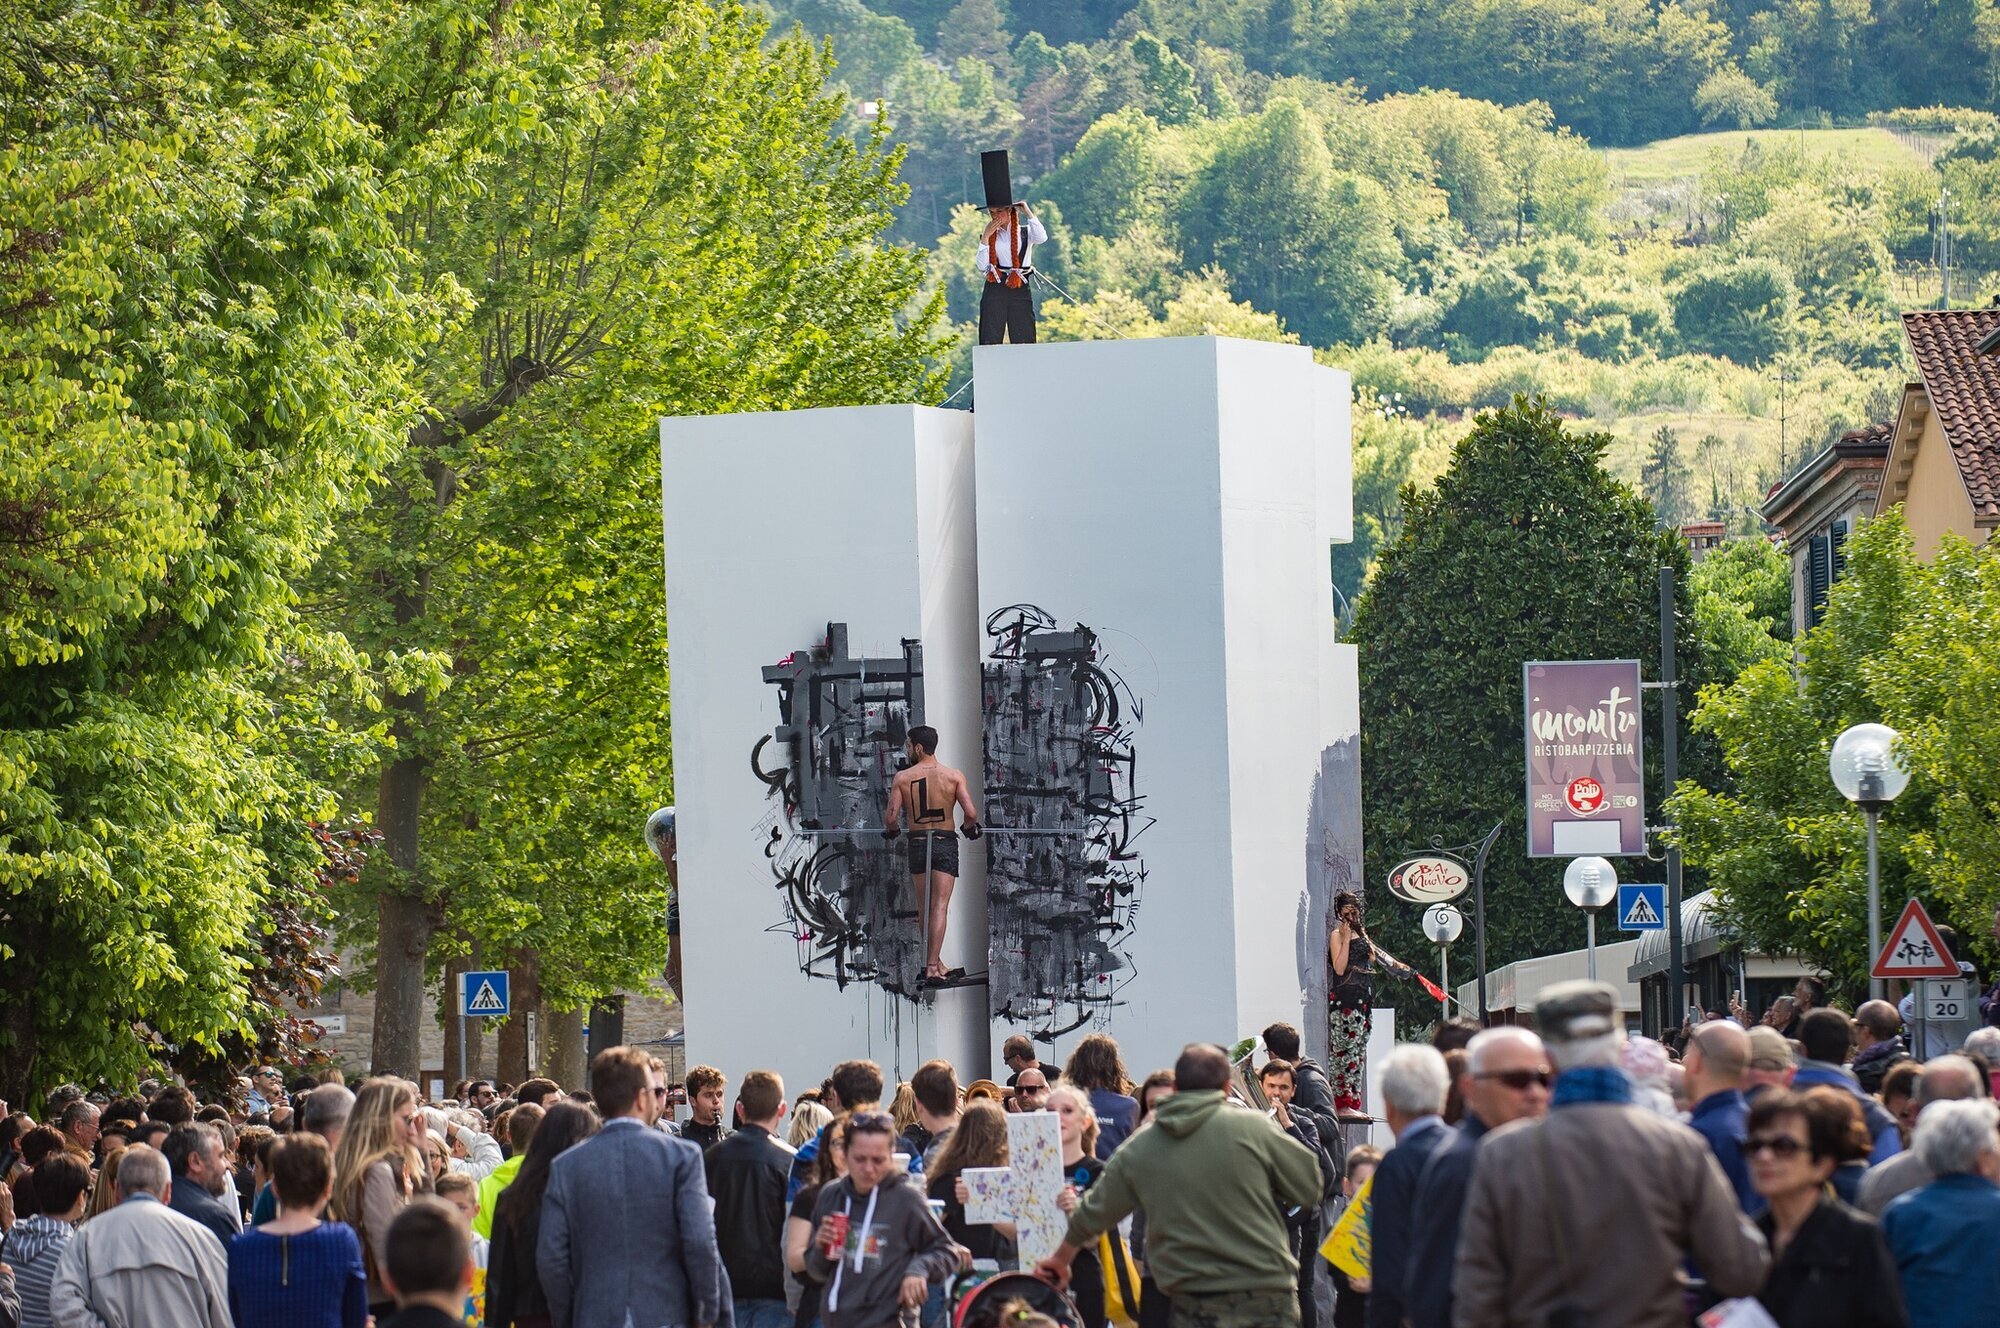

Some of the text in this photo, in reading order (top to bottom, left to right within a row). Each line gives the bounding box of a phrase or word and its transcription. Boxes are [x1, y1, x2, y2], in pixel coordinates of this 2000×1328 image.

[1534, 743, 1634, 757] RISTOBARPIZZERIA
[910, 777, 945, 825] L
[1940, 985, 1951, 997] V
[1936, 1003, 1958, 1016] 20
